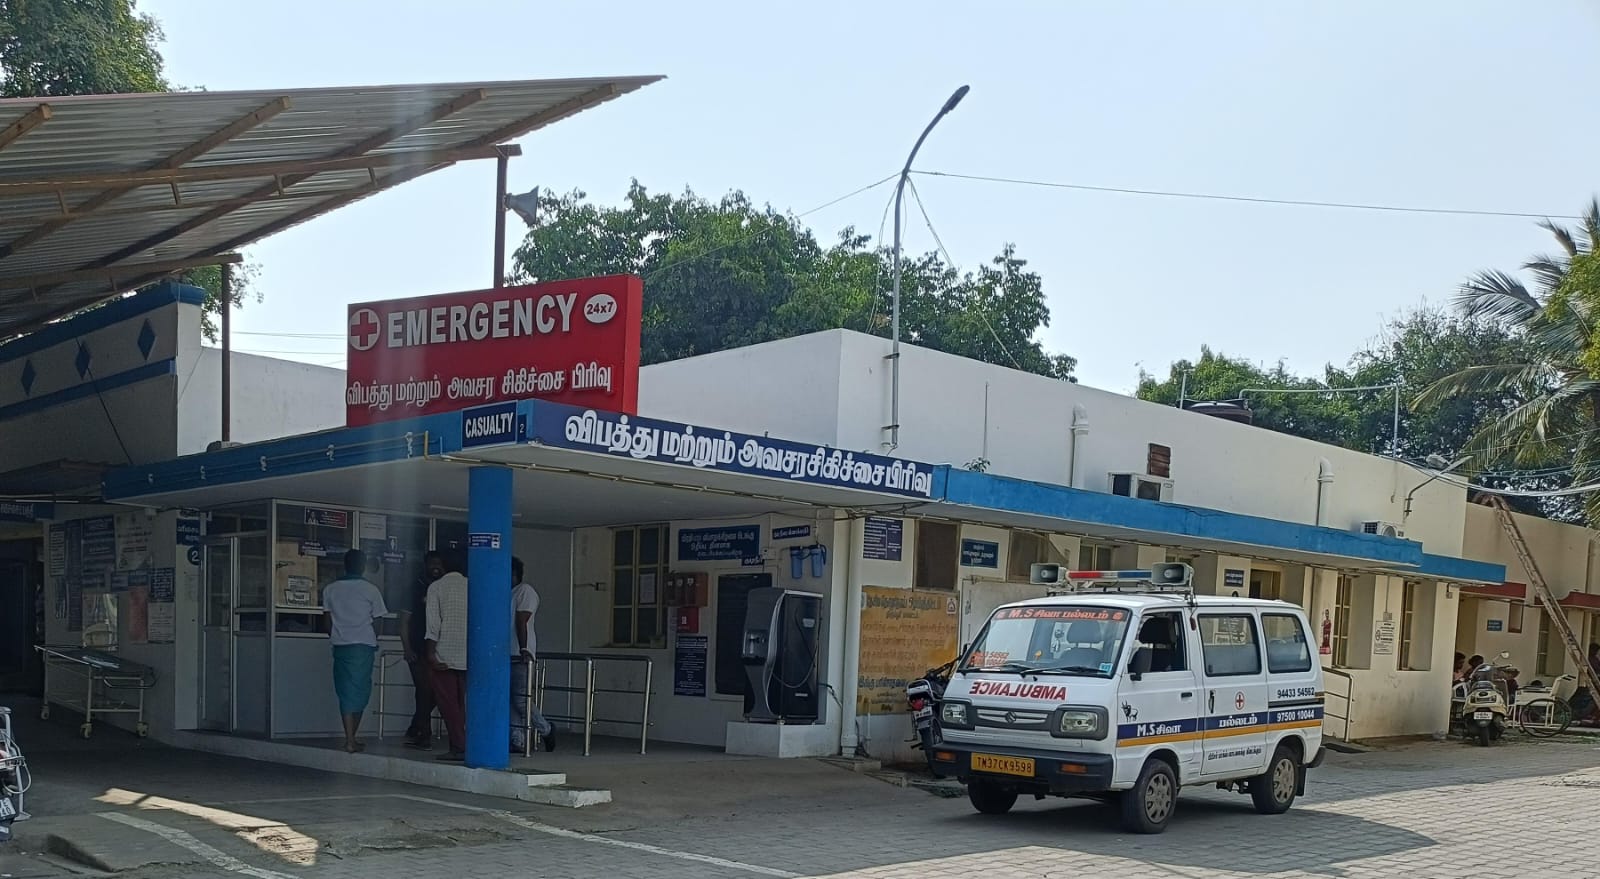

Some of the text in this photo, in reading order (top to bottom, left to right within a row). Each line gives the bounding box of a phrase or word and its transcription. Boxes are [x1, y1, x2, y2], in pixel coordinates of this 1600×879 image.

[387, 292, 616, 349] EMERGENCY 24x7
[346, 360, 612, 411] விபத்து மற்றும் அவசர சிகிச்சை பிரிவு
[464, 411, 514, 439] CASUALTY
[519, 423, 525, 434] 2
[565, 408, 932, 498] விபத்து மற்றும் அவசர சிகிச்சை பிரிவு
[191, 550, 200, 562] 2
[1008, 608, 1033, 618] M.S
[1277, 688, 1296, 698] 94433
[1277, 709, 1315, 722] 97500 10044
[1137, 713, 1258, 737] M.S சிவா பல்லடம்
[977, 757, 1032, 773] TN37CK9598
